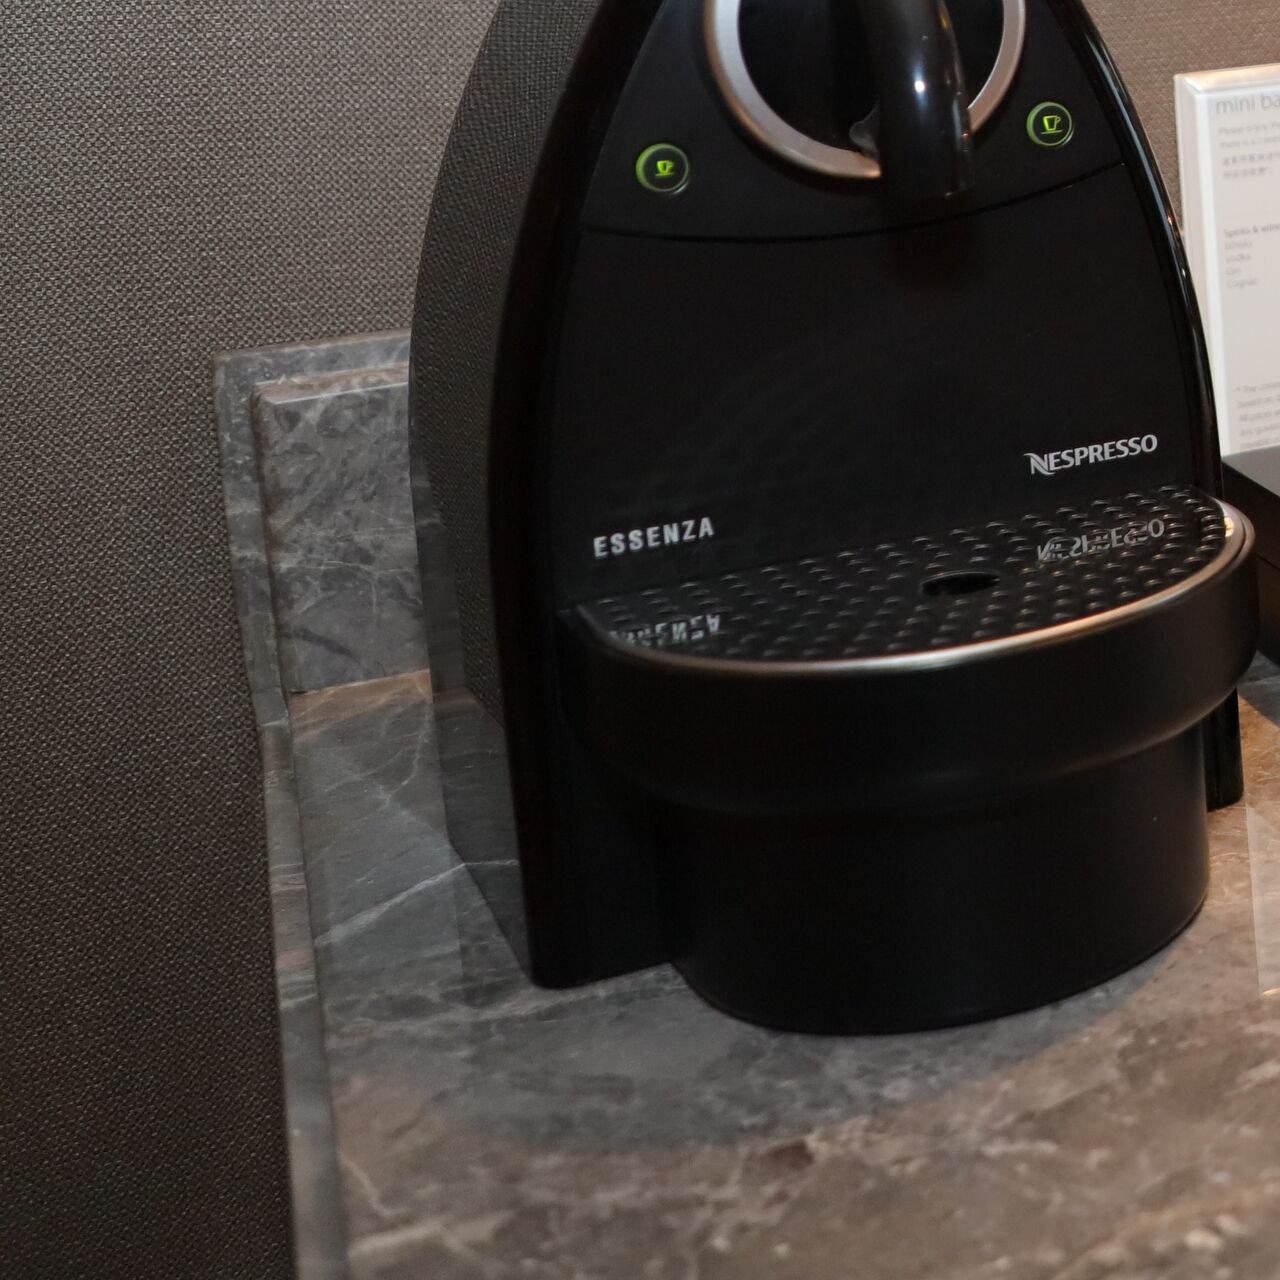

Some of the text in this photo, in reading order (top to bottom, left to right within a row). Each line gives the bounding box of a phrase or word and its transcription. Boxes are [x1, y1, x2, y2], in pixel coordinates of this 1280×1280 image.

[1215, 96, 1256, 115] mini
[1023, 434, 1158, 476] NESPRESSO
[593, 517, 715, 559] ESSENZA
